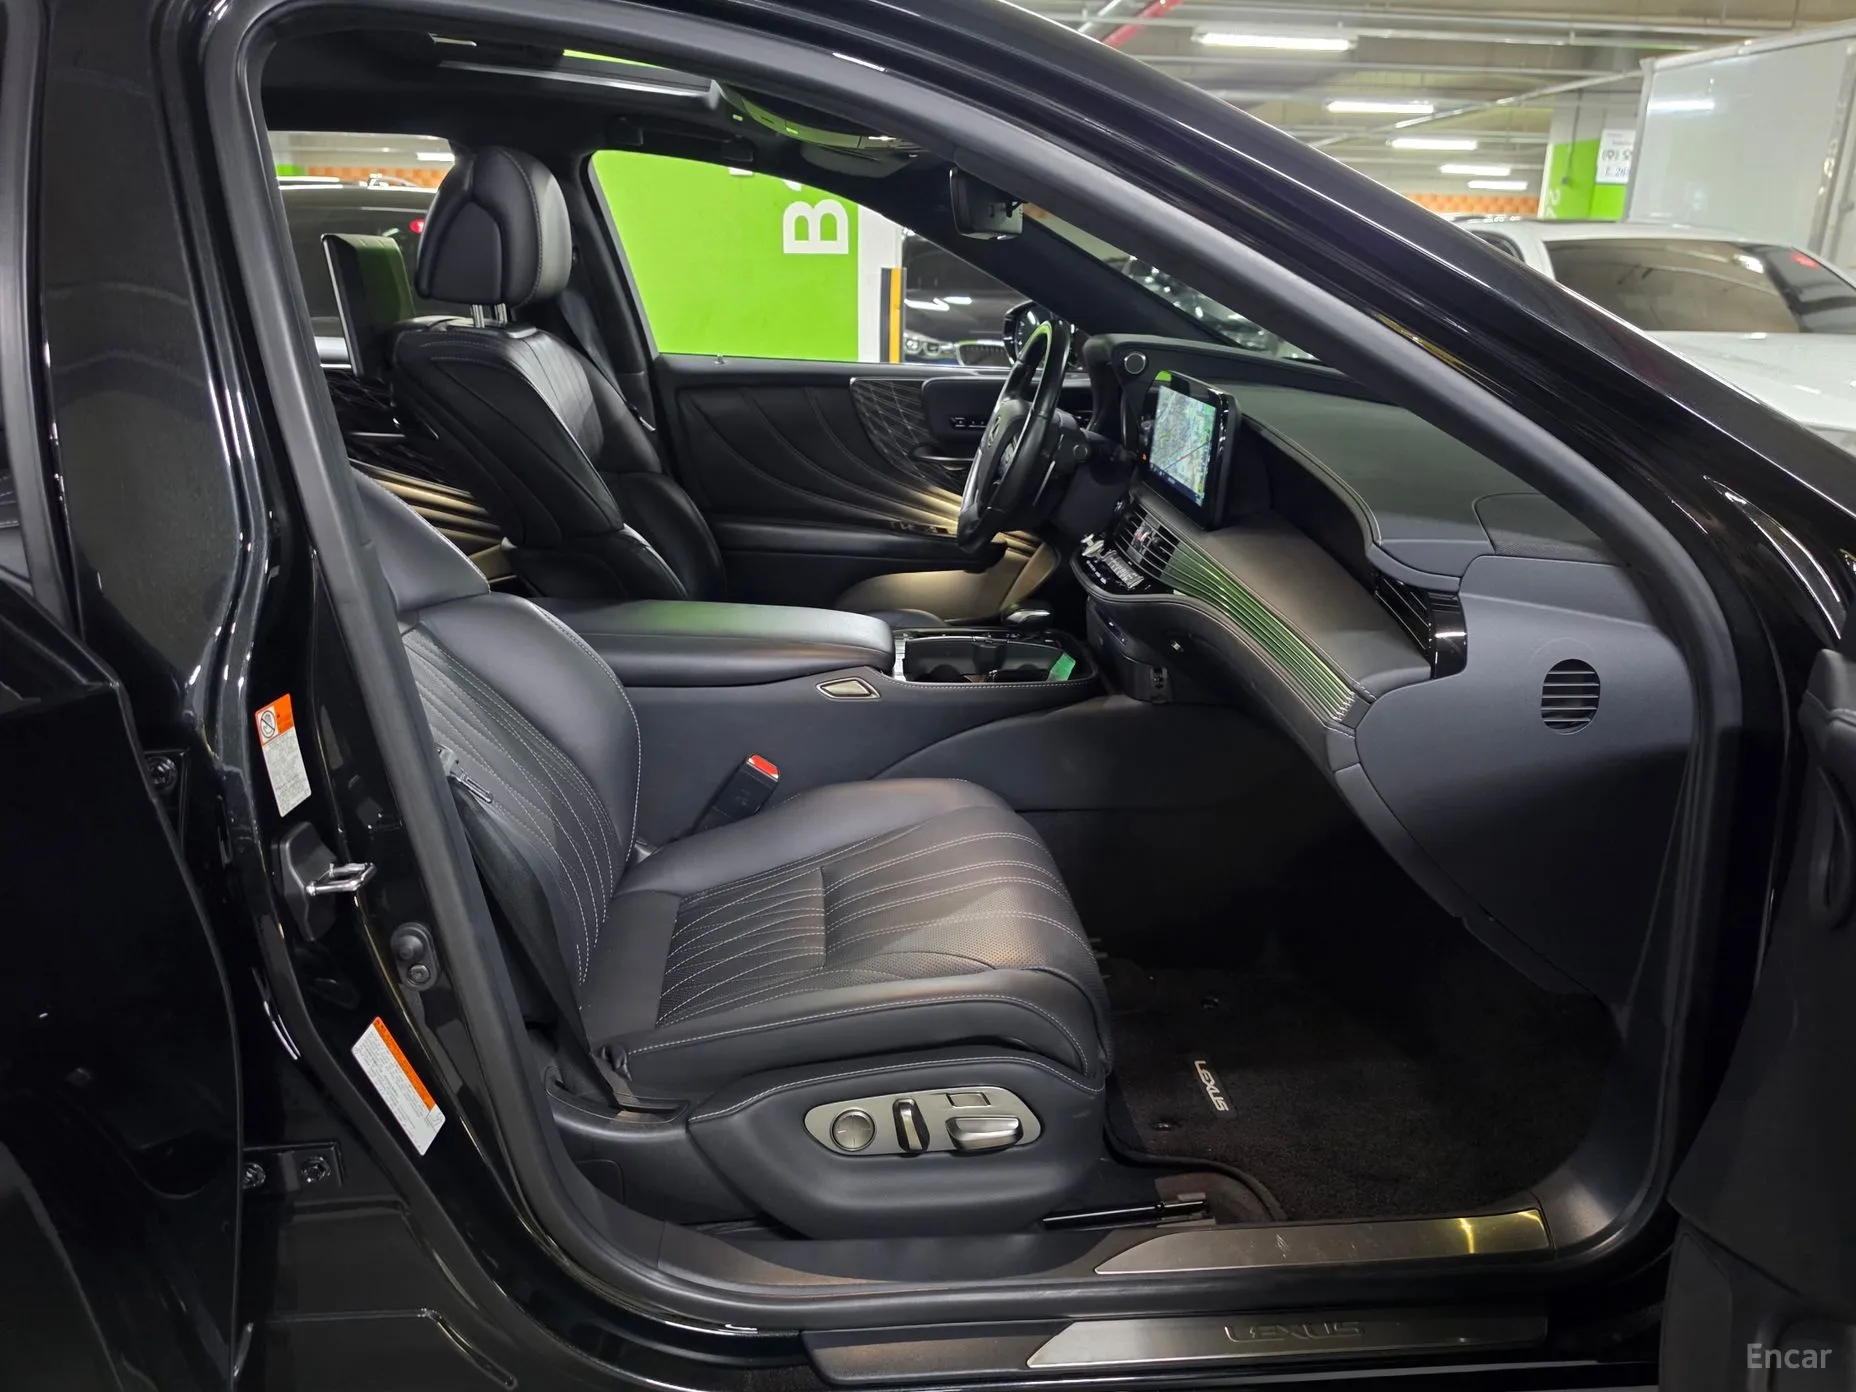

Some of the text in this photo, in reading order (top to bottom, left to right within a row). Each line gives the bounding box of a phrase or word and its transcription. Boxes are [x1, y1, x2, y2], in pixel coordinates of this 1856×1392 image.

[783, 180, 849, 255] B
[1194, 1060, 1230, 1112] LEXUS
[1224, 1321, 1364, 1343] LEXUS
